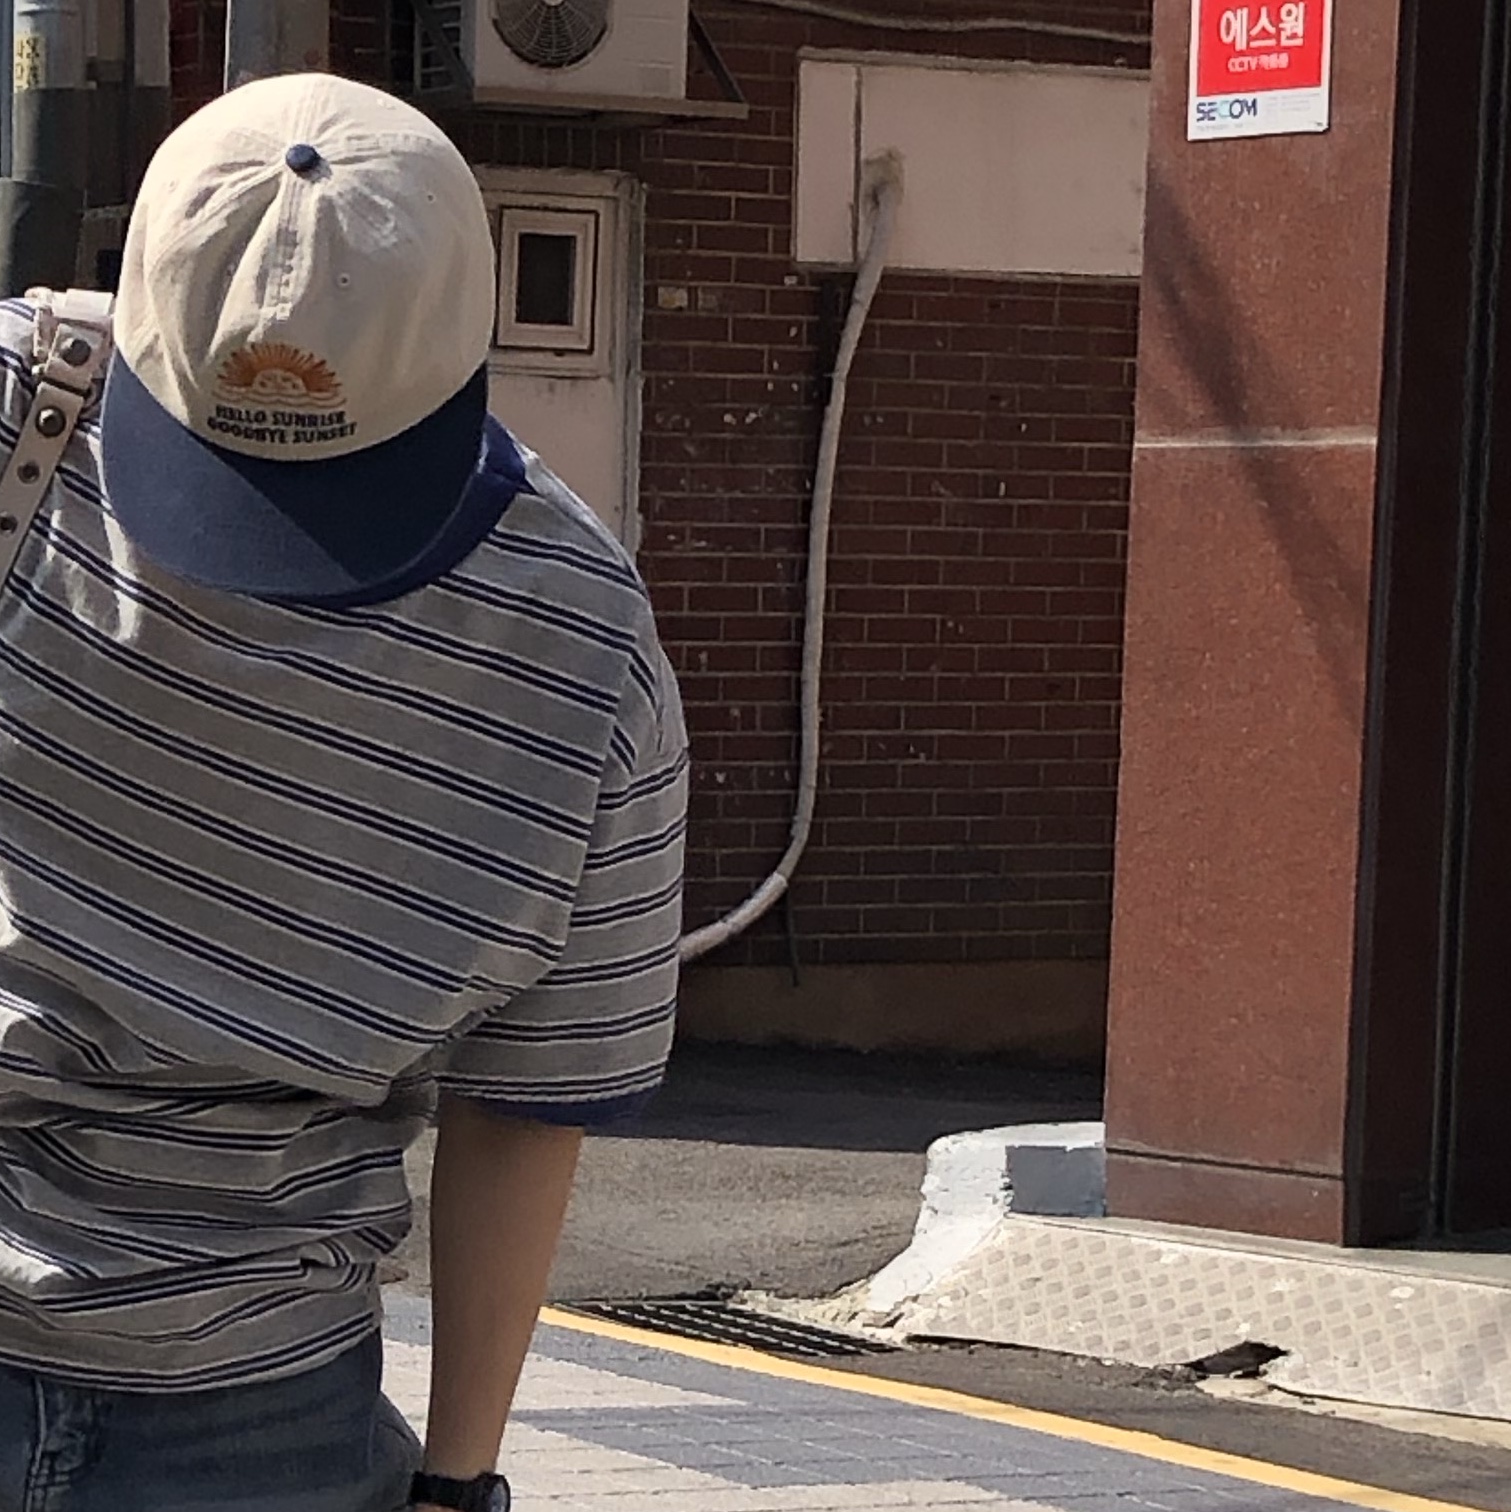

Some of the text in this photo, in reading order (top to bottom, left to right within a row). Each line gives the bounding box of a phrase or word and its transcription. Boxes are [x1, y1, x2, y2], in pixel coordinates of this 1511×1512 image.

[1219, 2, 1306, 51] 에스원
[1196, 98, 1258, 122] SECOM
[215, 405, 346, 427] HELLO SUNRISE
[207, 416, 357, 444] GOODBYE SUNSET
